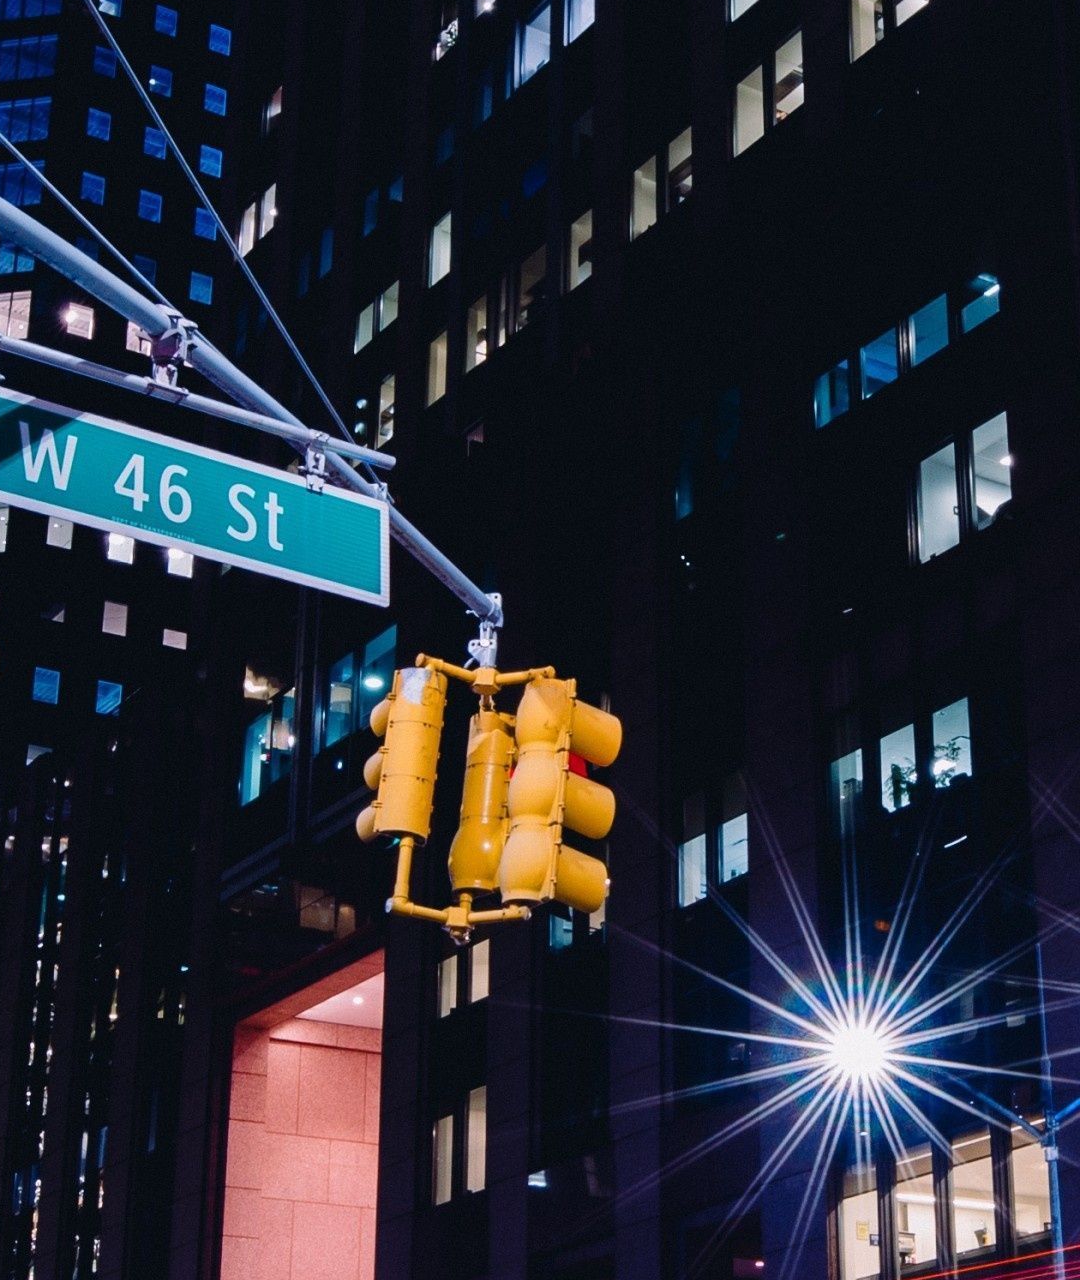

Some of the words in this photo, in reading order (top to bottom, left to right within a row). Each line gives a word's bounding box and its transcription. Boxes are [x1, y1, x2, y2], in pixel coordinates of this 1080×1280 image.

[18, 421, 78, 491] W
[113, 453, 193, 524] 46
[226, 482, 285, 552] St
